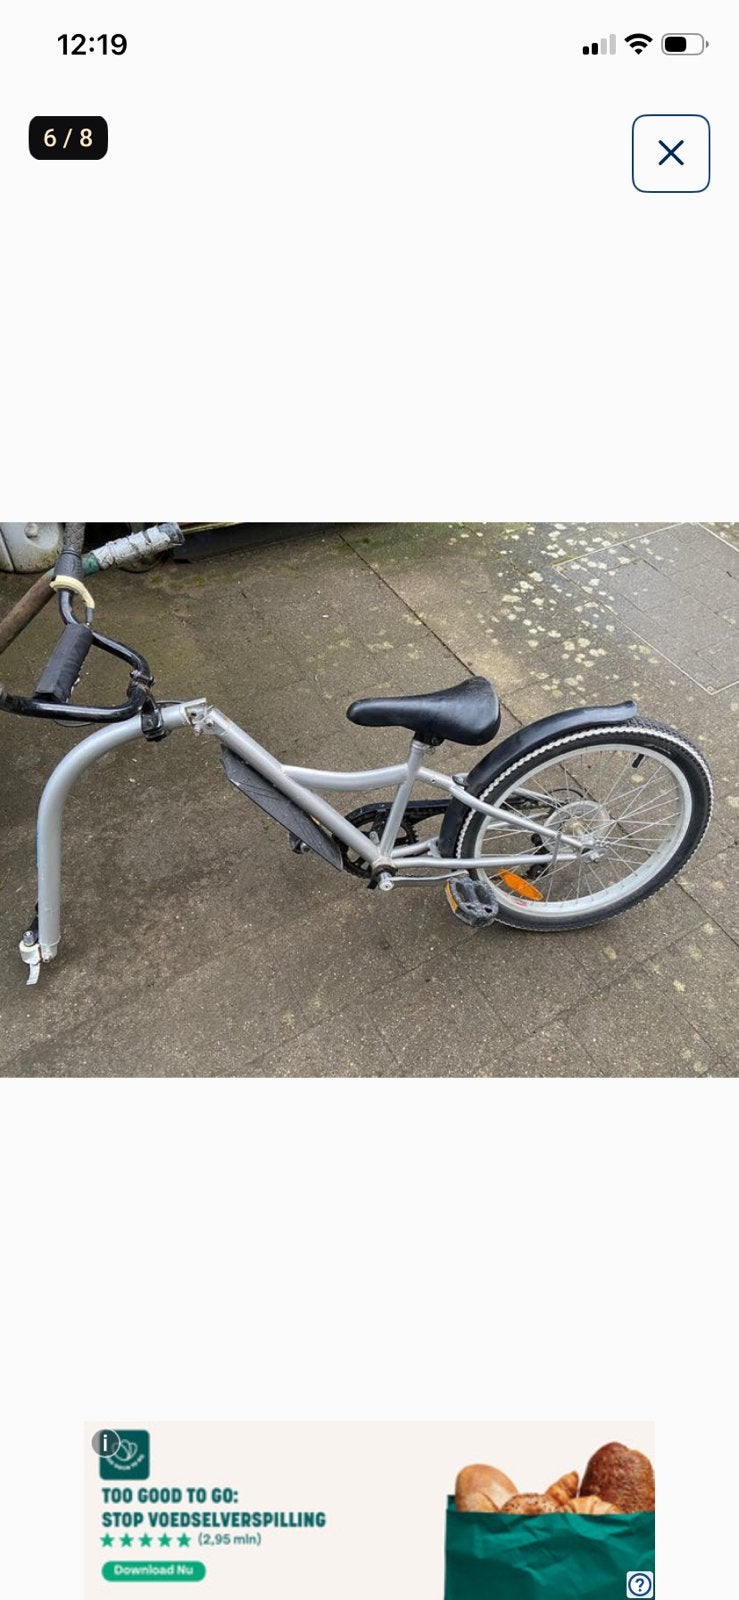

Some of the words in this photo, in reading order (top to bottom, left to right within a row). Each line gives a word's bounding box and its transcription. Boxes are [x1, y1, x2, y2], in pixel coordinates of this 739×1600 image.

[57, 32, 128, 57] 12:19
[101, 1487, 133, 1504] TOO
[137, 1487, 183, 1504] GOOD
[186, 1487, 207, 1504] TO
[211, 1487, 239, 1504] GO:
[101, 1511, 144, 1528] STOP
[148, 1511, 327, 1528] VOEDSELVERSPILLING
[198, 1532, 231, 1547] (2,95
[233, 1532, 262, 1547] mln)
[113, 1564, 175, 1576] Download
[176, 1564, 194, 1576] Nu
